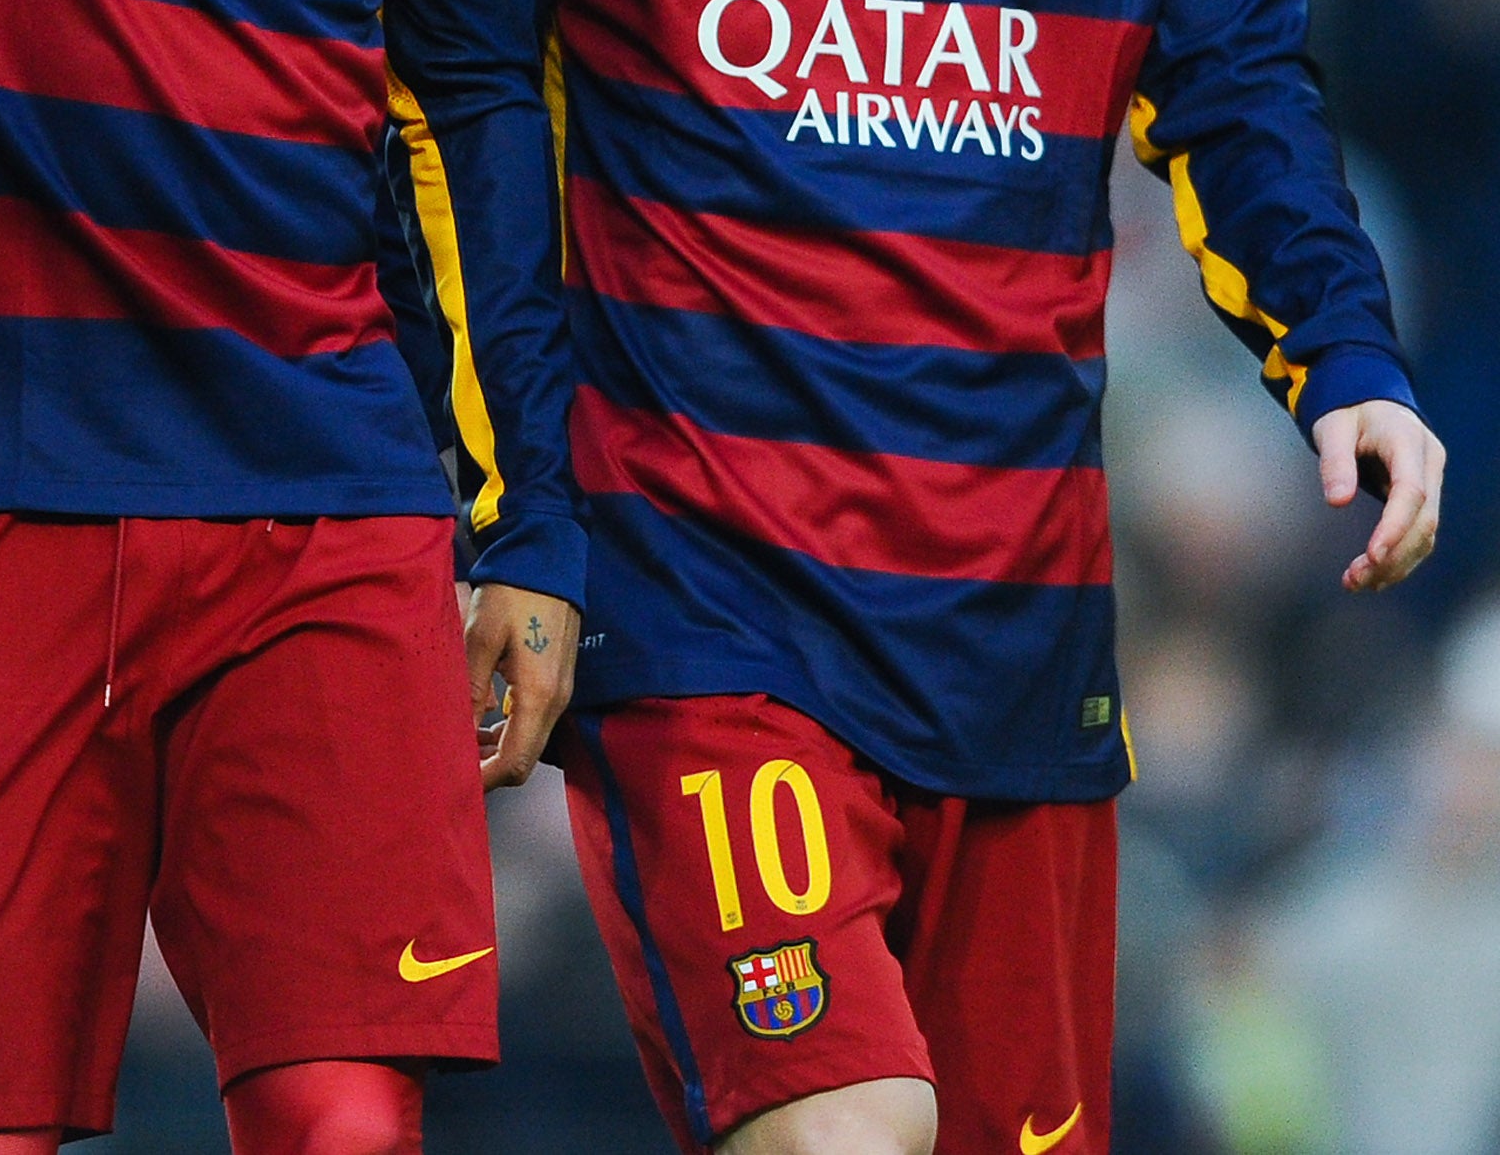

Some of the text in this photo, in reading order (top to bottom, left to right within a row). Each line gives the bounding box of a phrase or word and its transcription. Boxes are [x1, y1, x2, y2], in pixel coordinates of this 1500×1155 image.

[786, 88, 1044, 161] AIRWAYS
[579, 632, 606, 650] -FIT
[680, 758, 832, 933] 10
